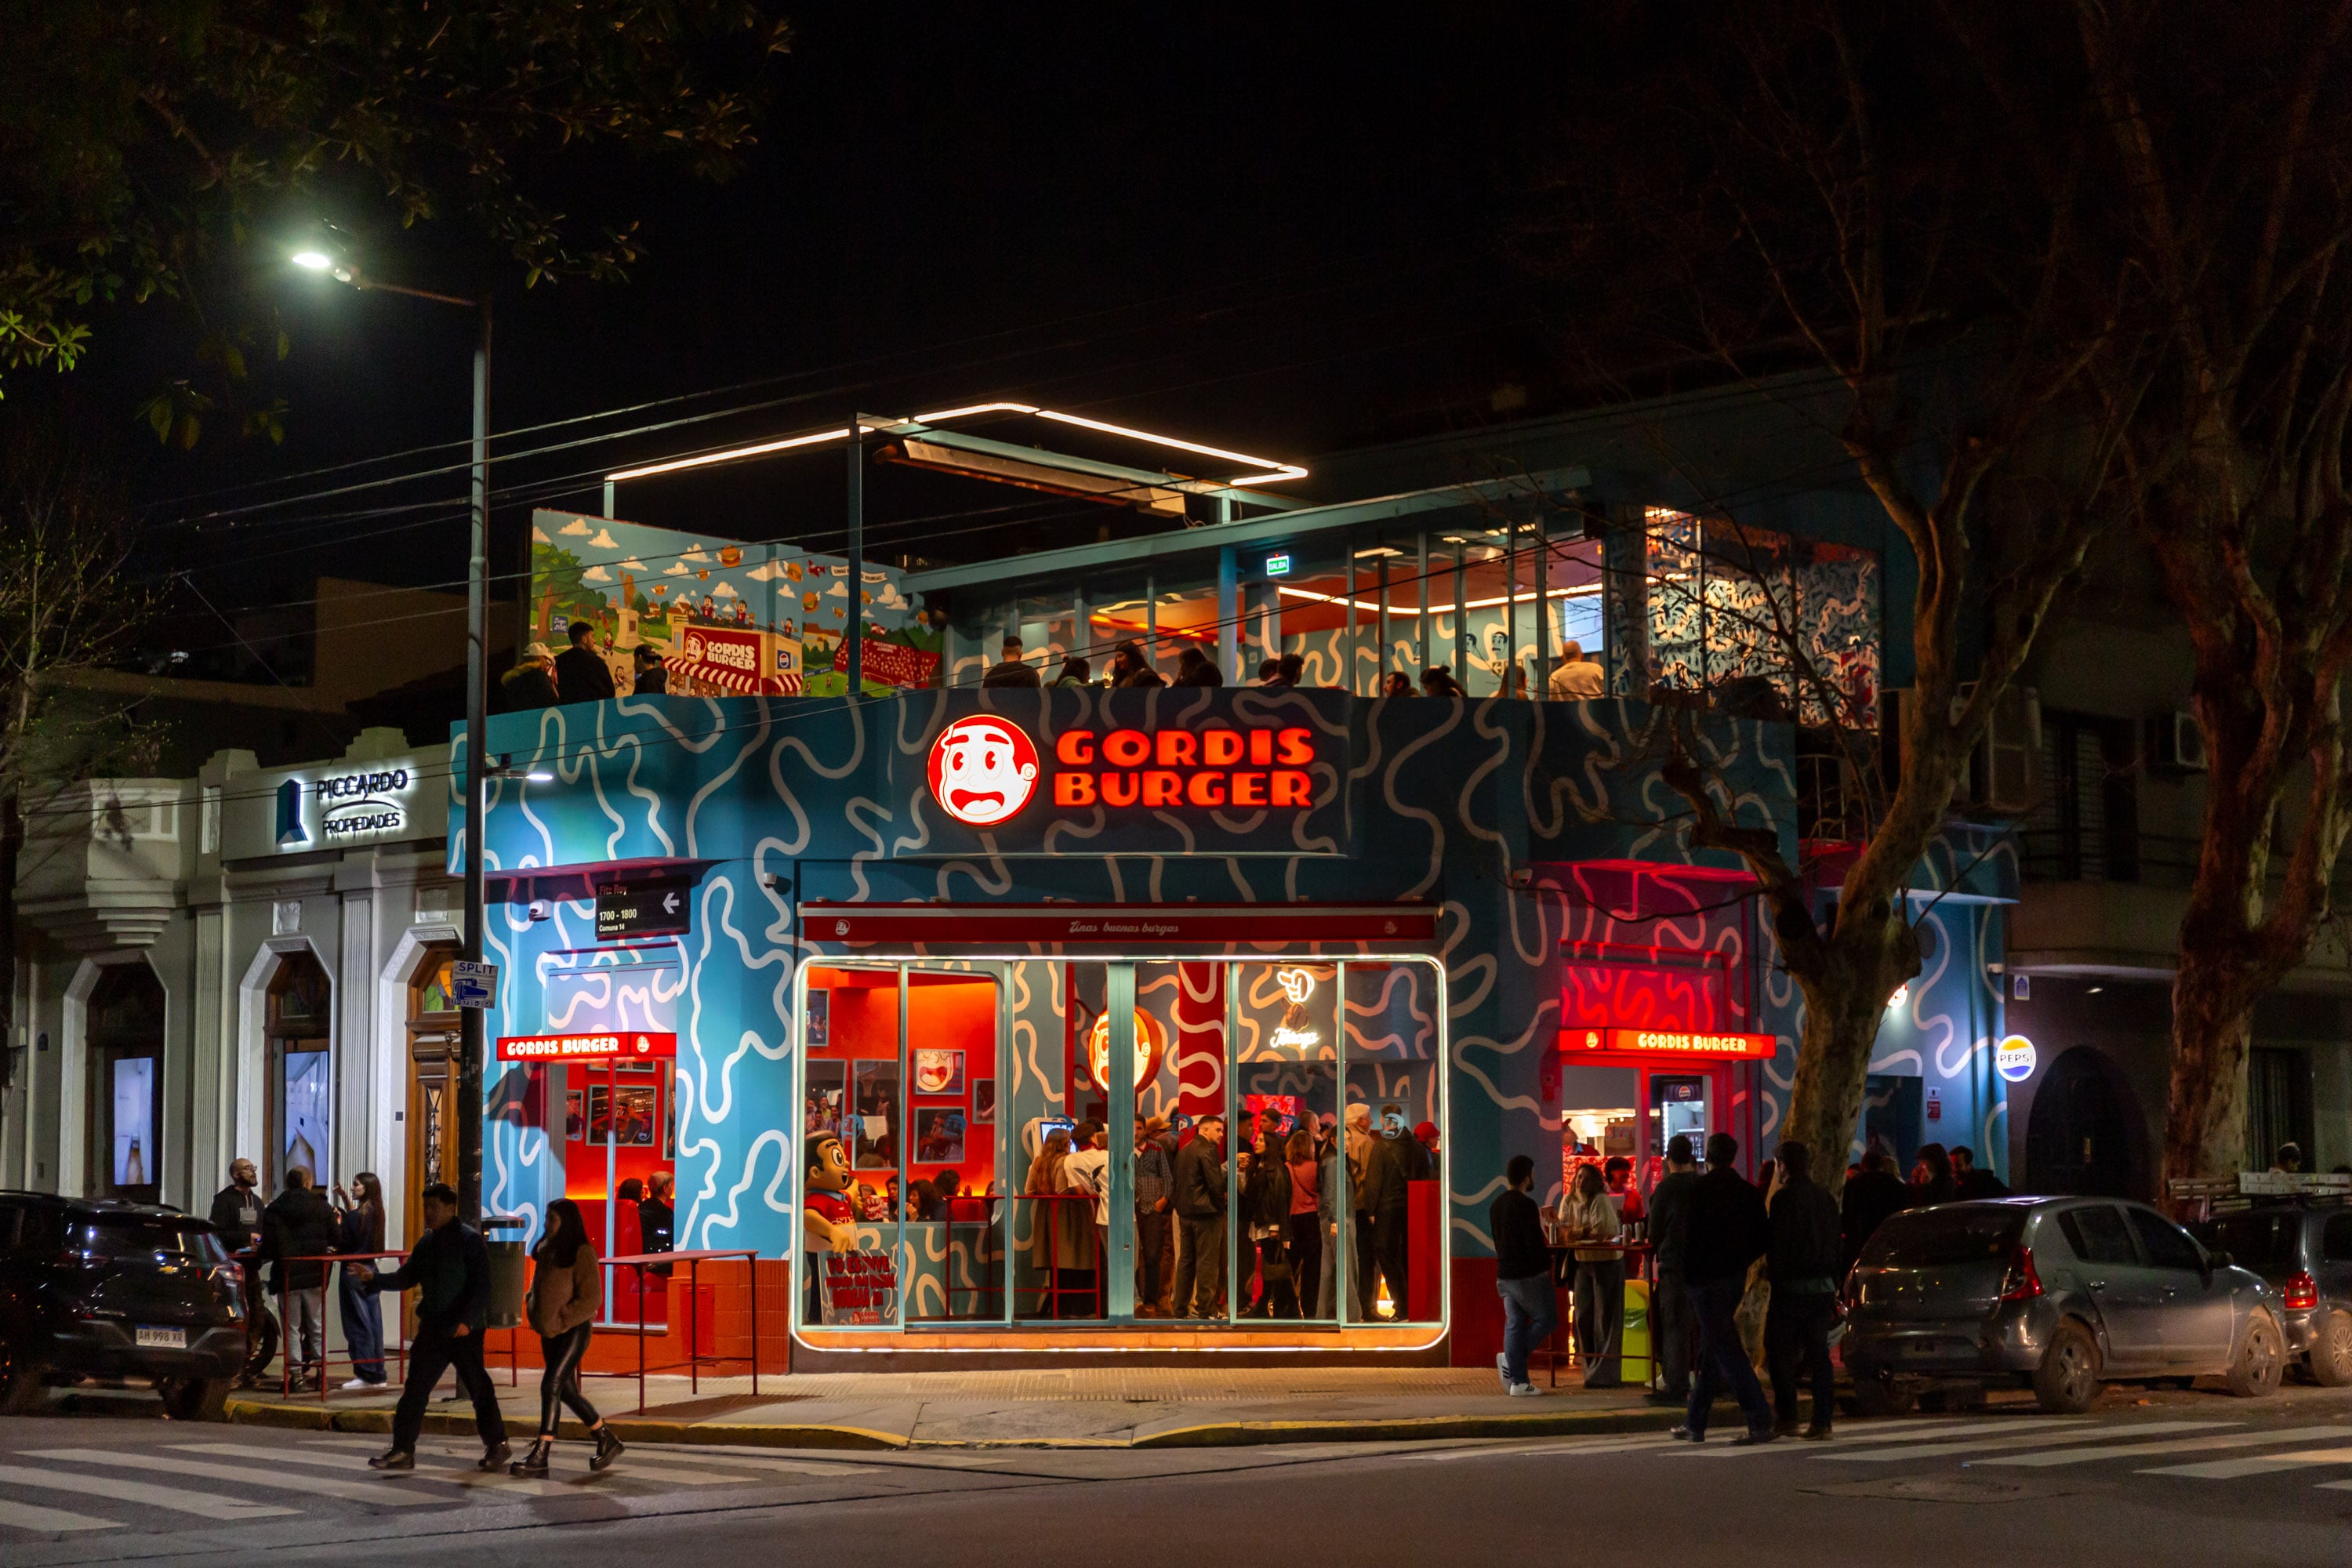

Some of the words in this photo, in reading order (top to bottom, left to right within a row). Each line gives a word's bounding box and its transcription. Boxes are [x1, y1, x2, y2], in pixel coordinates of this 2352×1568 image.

[707, 641, 755, 659] GORDIS
[707, 652, 756, 671] BURGER
[1056, 728, 1314, 767] GORDIS
[317, 769, 408, 800] PICCARDO
[1054, 771, 1312, 807] BURGER
[322, 812, 400, 834] PROPIEDADES
[599, 886, 612, 895] Fitz
[614, 884, 627, 895] Roy
[599, 910, 615, 921] 1700
[621, 909, 637, 920] 1800
[1069, 920, 1098, 933] Unas
[1103, 922, 1140, 933] buenas
[1142, 923, 1179, 936] burgas
[459, 962, 495, 975] SPLIT
[506, 1040, 559, 1056] GORDIS
[562, 1037, 619, 1054] BURGER
[1638, 1033, 1690, 1049] GORDIS
[1693, 1036, 1747, 1051] BURGER
[2000, 1054, 2033, 1062] PEPSI
